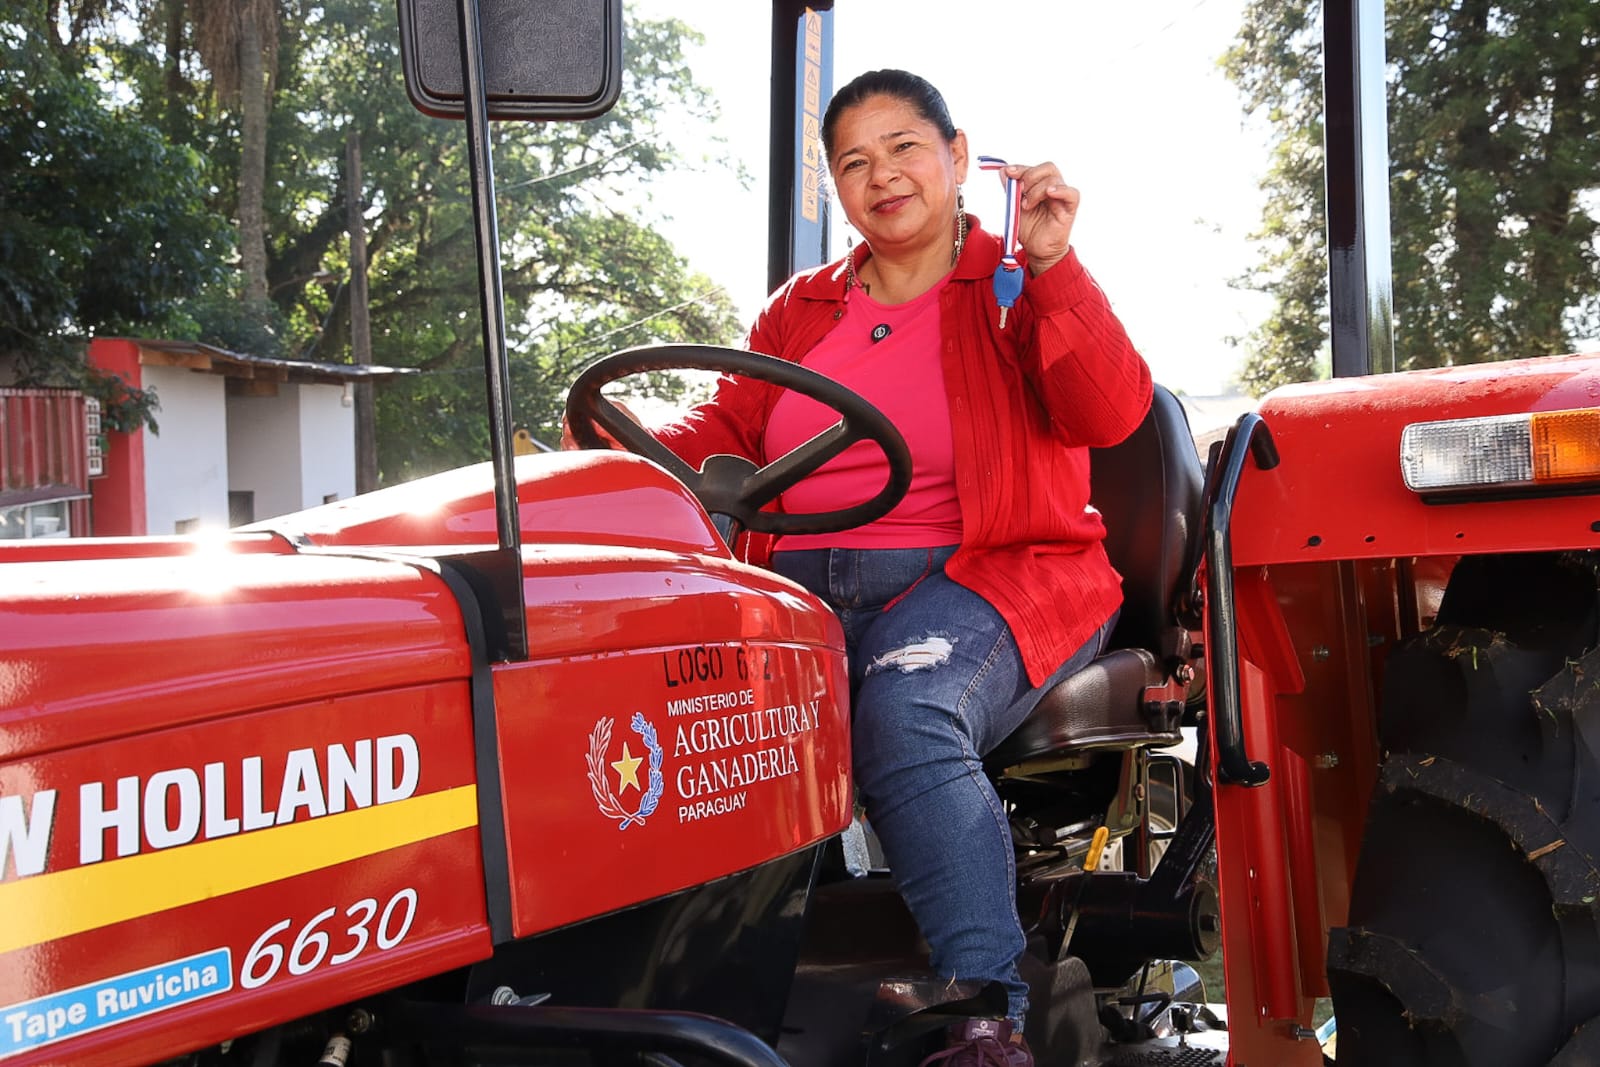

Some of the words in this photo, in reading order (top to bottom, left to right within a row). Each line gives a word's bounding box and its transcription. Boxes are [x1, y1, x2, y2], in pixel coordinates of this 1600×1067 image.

[664, 646, 724, 688] LOGO
[667, 692, 738, 717] MINISTERIO
[739, 689, 755, 705] DE
[673, 704, 811, 758] AGRICULTURA
[810, 700, 820, 729] Y
[80, 733, 420, 865] HOLLAND
[676, 743, 799, 799] GANADERIA
[678, 791, 748, 824] PARAGUAY
[239, 888, 418, 990] 6630
[5, 1002, 87, 1043] Tape
[96, 964, 219, 1017] Ruvicha
